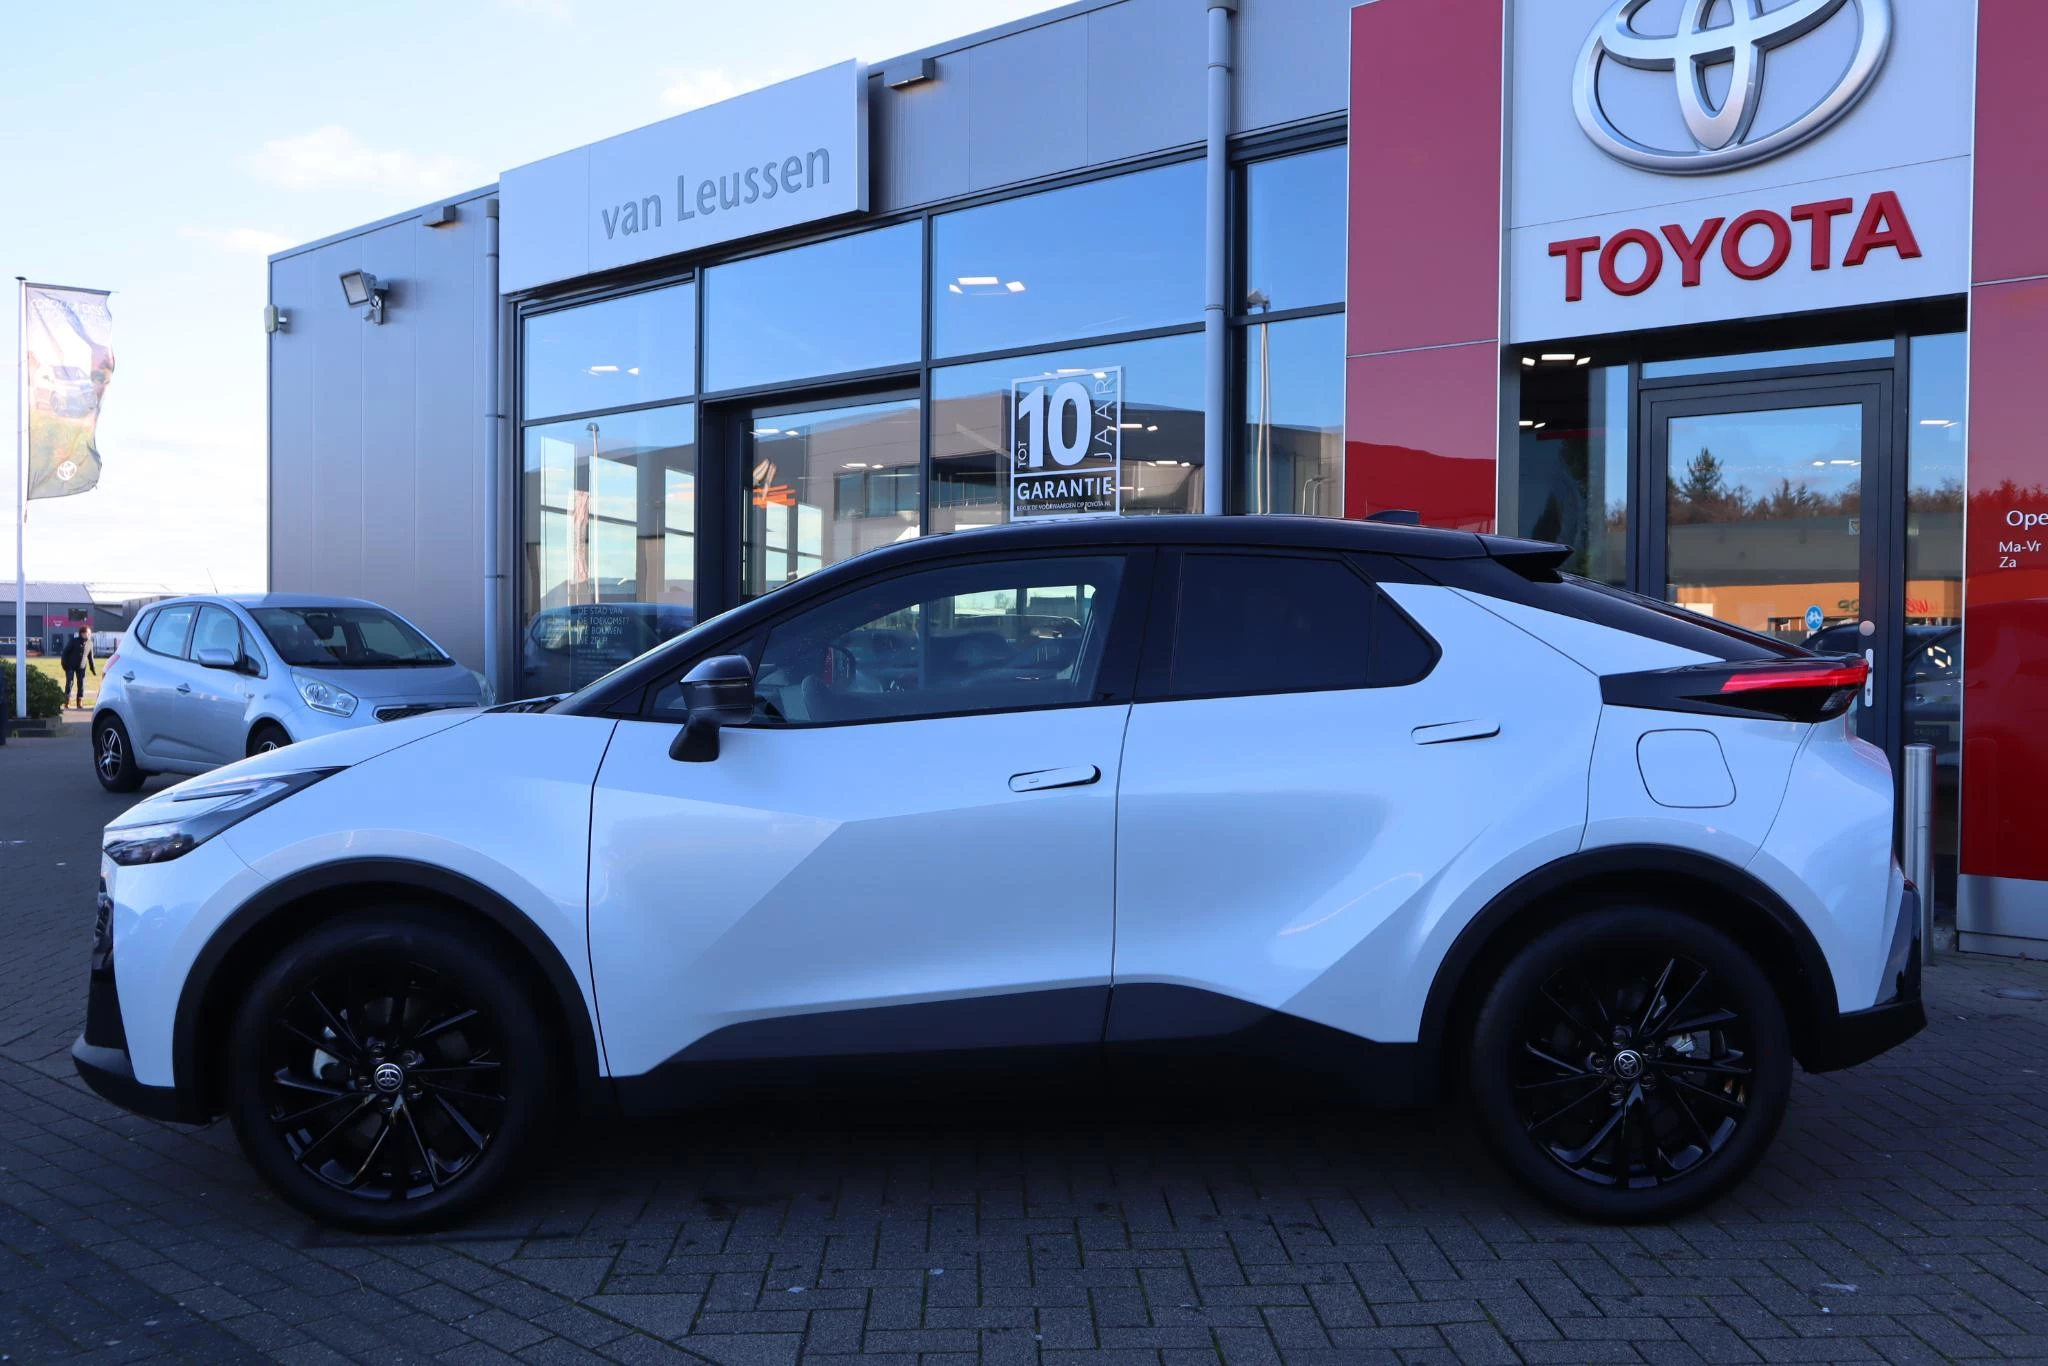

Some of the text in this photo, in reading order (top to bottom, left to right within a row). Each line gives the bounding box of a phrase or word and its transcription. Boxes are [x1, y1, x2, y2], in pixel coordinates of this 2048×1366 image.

[602, 148, 830, 240] van Leussen
[1548, 190, 1922, 302] TOYOTA
[1018, 381, 1092, 468] 10
[1094, 377, 1113, 462] JAAR
[1018, 441, 1027, 469] TOT
[1017, 477, 1112, 500] GARANTIE
[1999, 540, 2042, 553] Ma-Vr
[1999, 556, 2017, 568] Za
[609, 606, 624, 615] VAN
